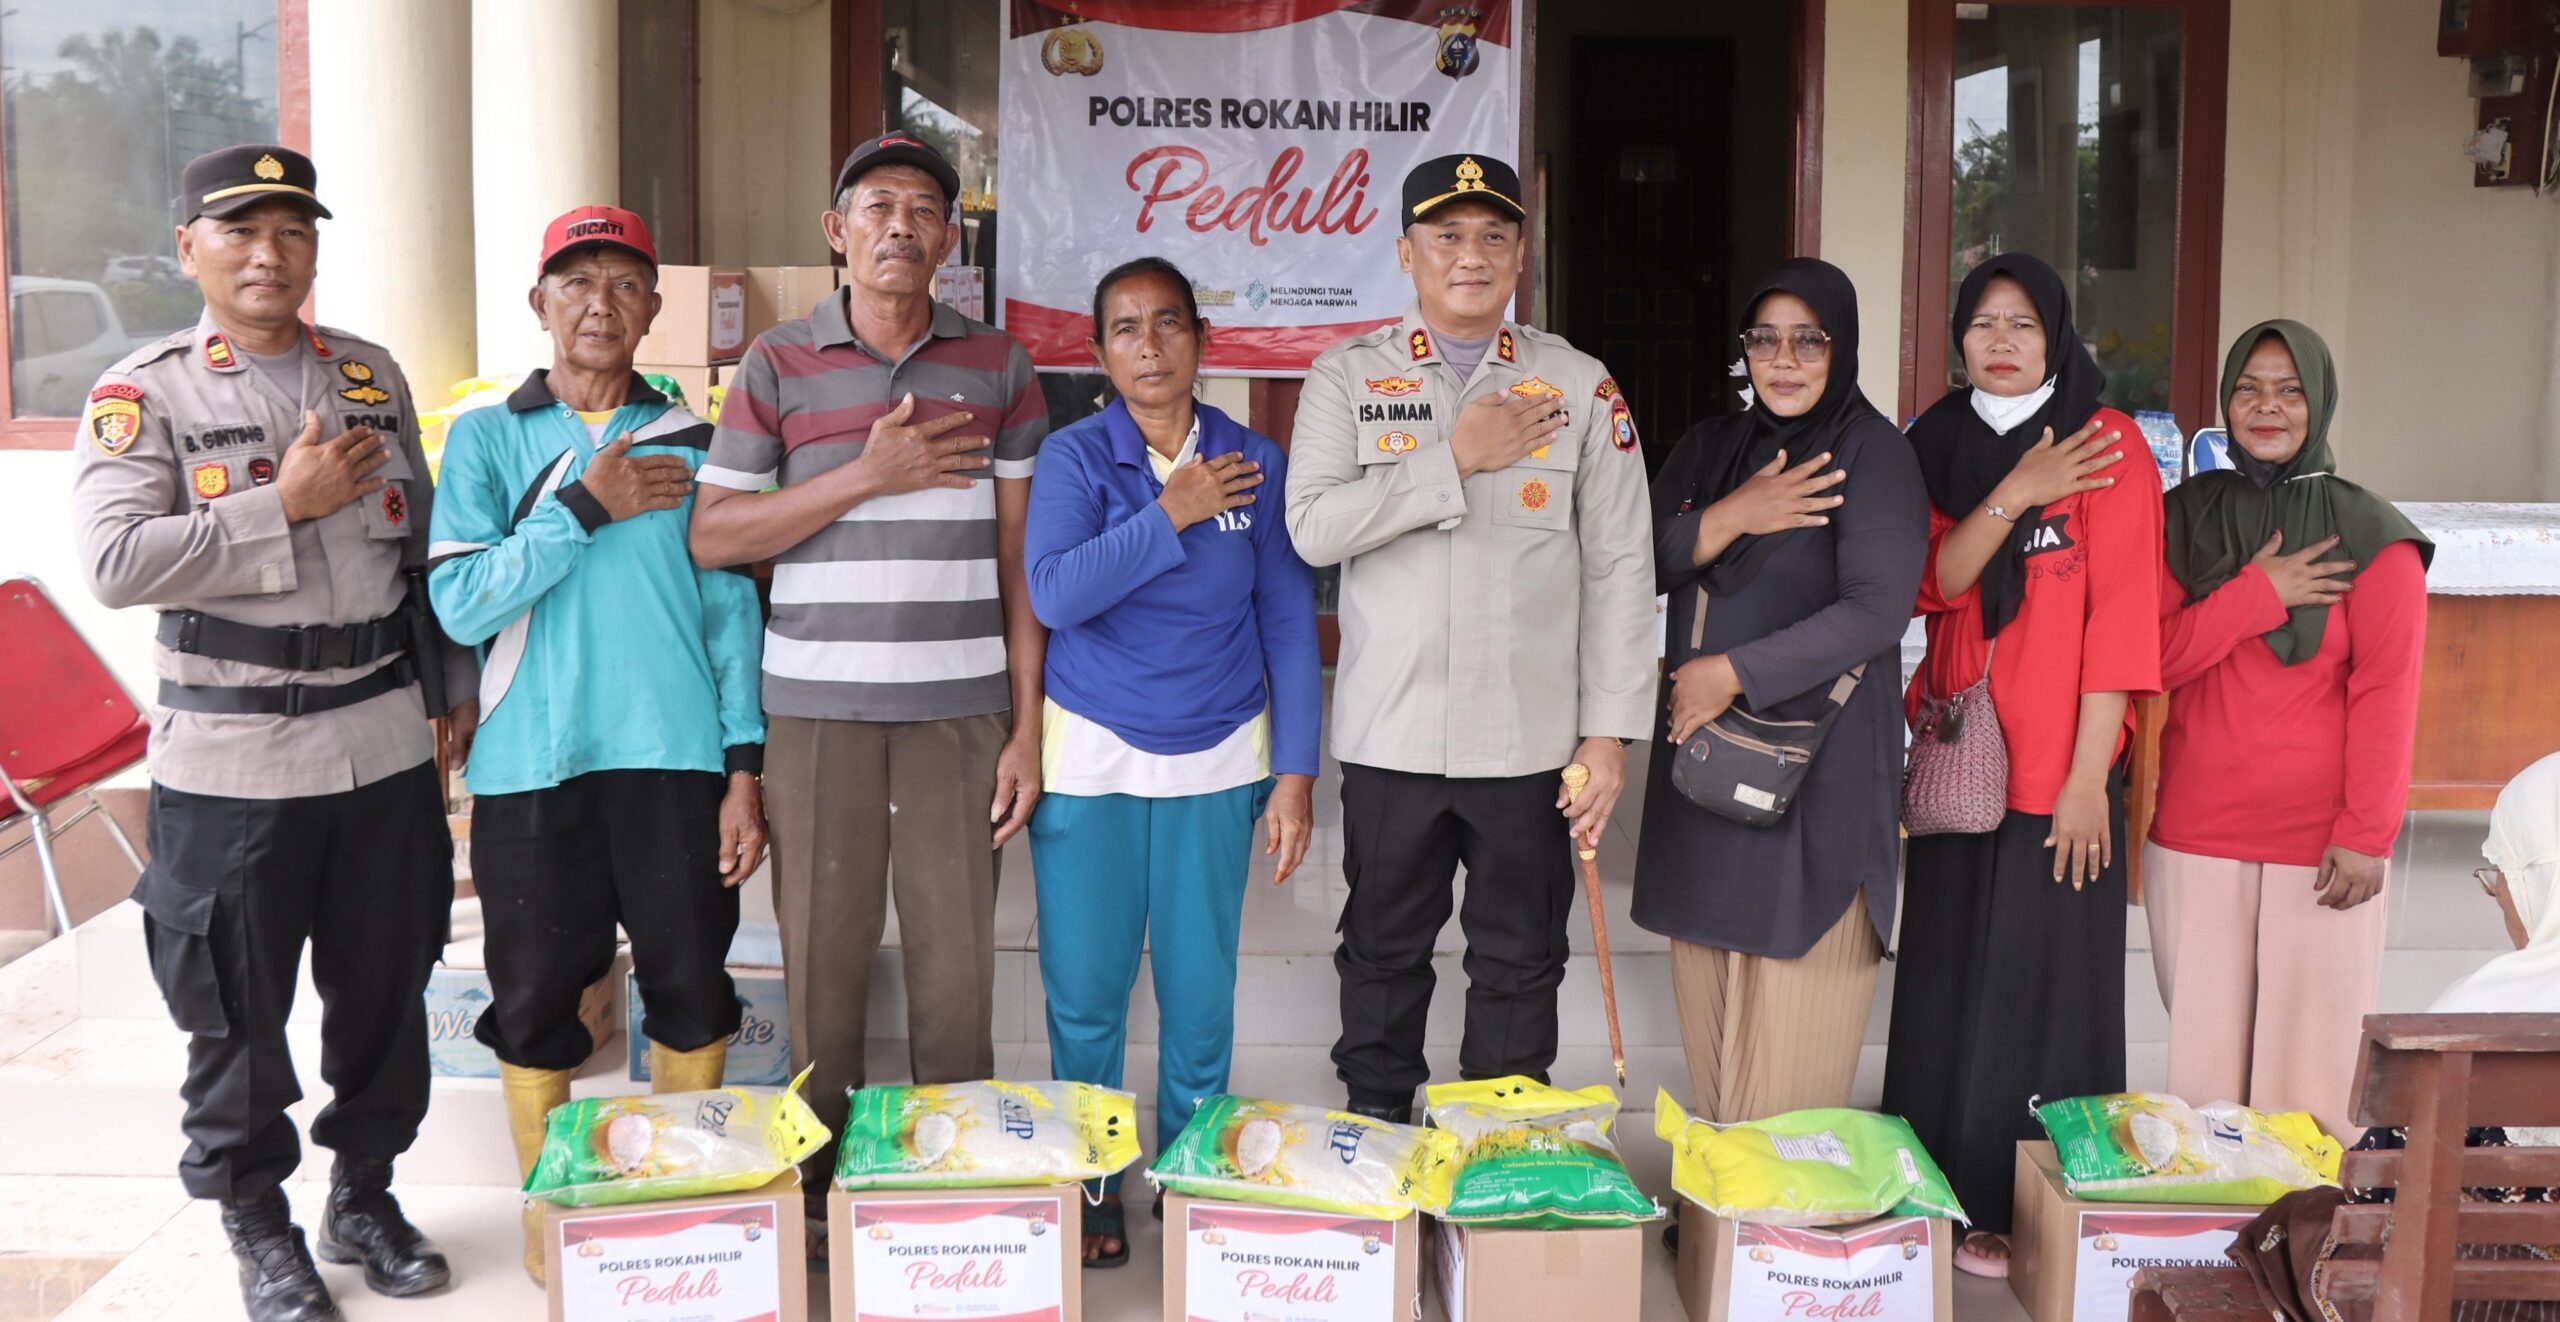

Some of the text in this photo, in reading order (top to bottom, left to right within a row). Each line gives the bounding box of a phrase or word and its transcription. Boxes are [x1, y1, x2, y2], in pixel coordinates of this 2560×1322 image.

[1088, 95, 1431, 132] POLRES ROKAN HILIR
[1126, 145, 1379, 247] Peduli
[566, 222, 624, 240] DUCATI
[1270, 287, 1353, 296] MELINDUNGI TUAH
[1270, 298, 1358, 307] MENJAGA MARWAH
[1359, 403, 1432, 422] ISA IMAM
[185, 425, 265, 452] B. GINTING
[1213, 508, 1252, 532] YLS
[599, 1251, 743, 1273] POLRES ROKAN HILIR
[889, 1244, 1027, 1257] POLRES ROKAN HILIR
[1221, 1252, 1360, 1272] POLRES ROKAN HILIR
[616, 1268, 722, 1306] Peduli
[904, 1259, 1007, 1292] Peduli
[1236, 1269, 1338, 1304] Peduli
[1767, 1271, 1903, 1291] POLRES ROKAN HILIR
[1782, 1291, 1884, 1322] Peduli
